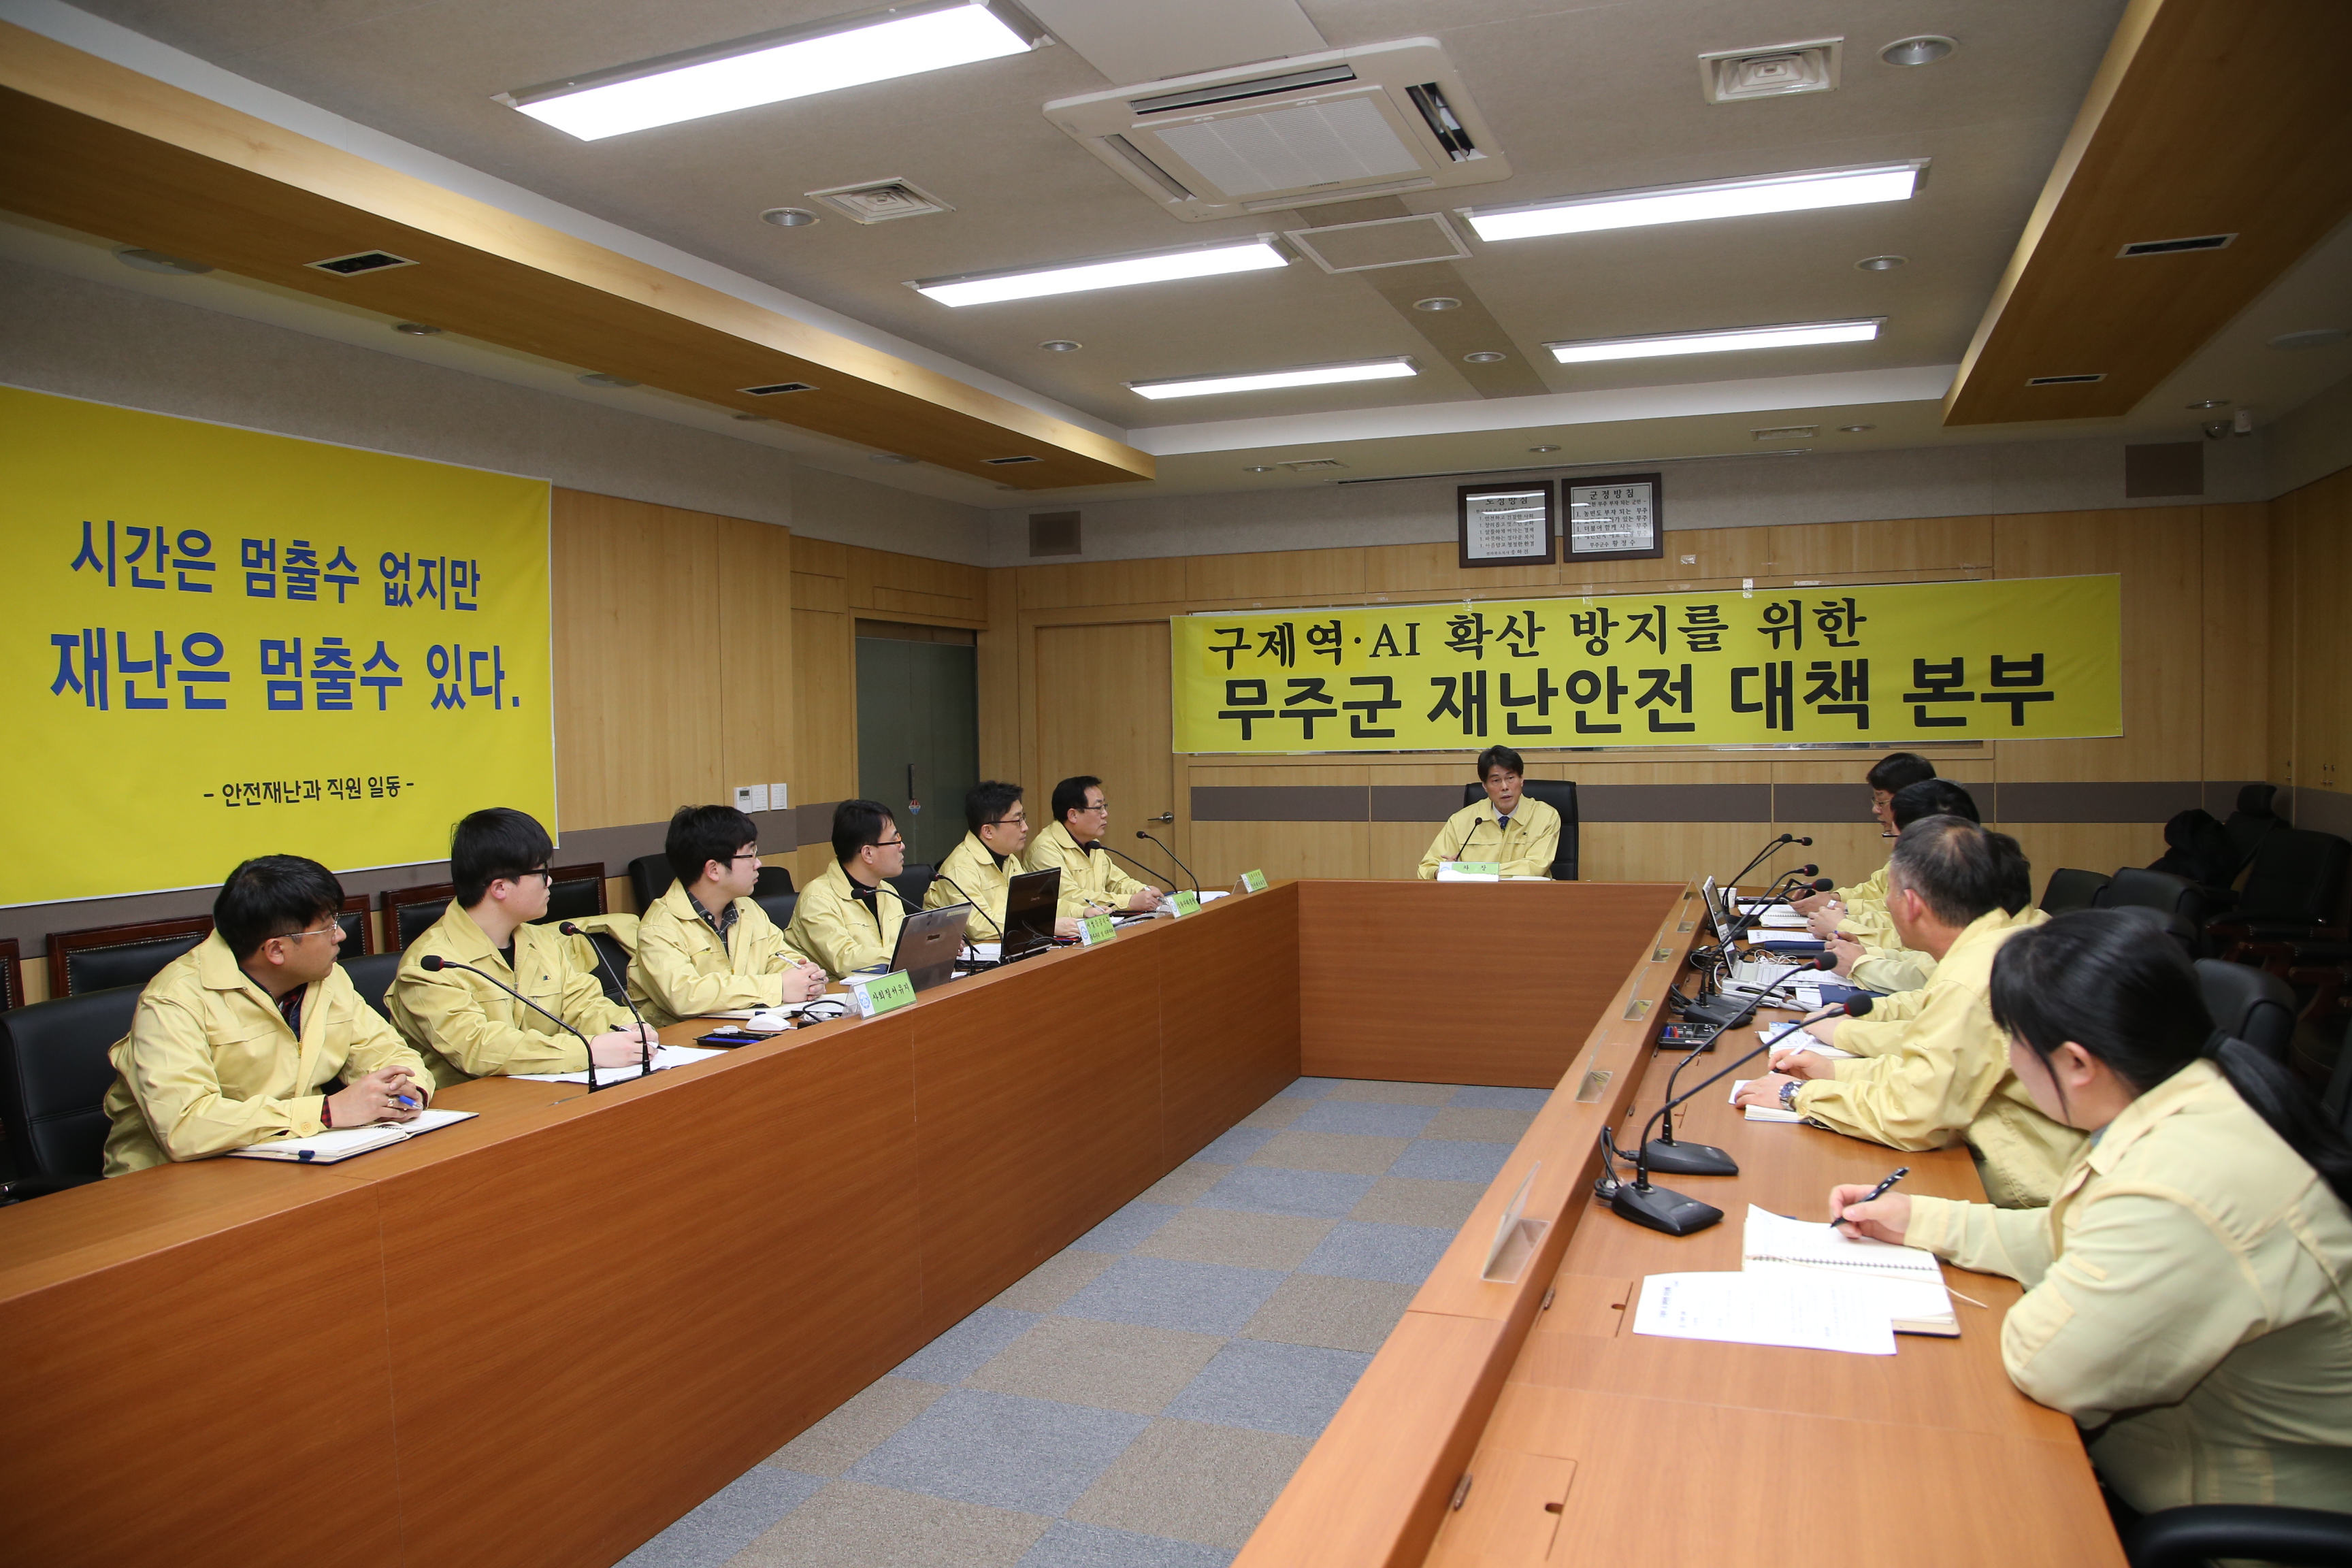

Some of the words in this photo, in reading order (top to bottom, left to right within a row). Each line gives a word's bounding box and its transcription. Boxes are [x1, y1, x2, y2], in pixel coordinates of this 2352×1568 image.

[71, 521, 215, 592] 시간은
[241, 538, 359, 604] 멈출수
[380, 552, 480, 611] 없지만
[1444, 610, 1546, 661] 확산
[1569, 604, 1730, 656] 방지를
[1757, 597, 1868, 651] 위한
[50, 627, 231, 710] 재난은
[261, 637, 403, 710] 멈출수
[426, 643, 520, 710] 있다.
[1218, 675, 1403, 740] 무주군
[1426, 664, 1696, 737] 재난안전
[1731, 658, 1870, 732] 대책
[1902, 653, 2055, 728] 본부
[327, 777, 362, 800] 직원
[368, 776, 401, 799] 일동
[872, 983, 911, 1002] 사회질서유지
